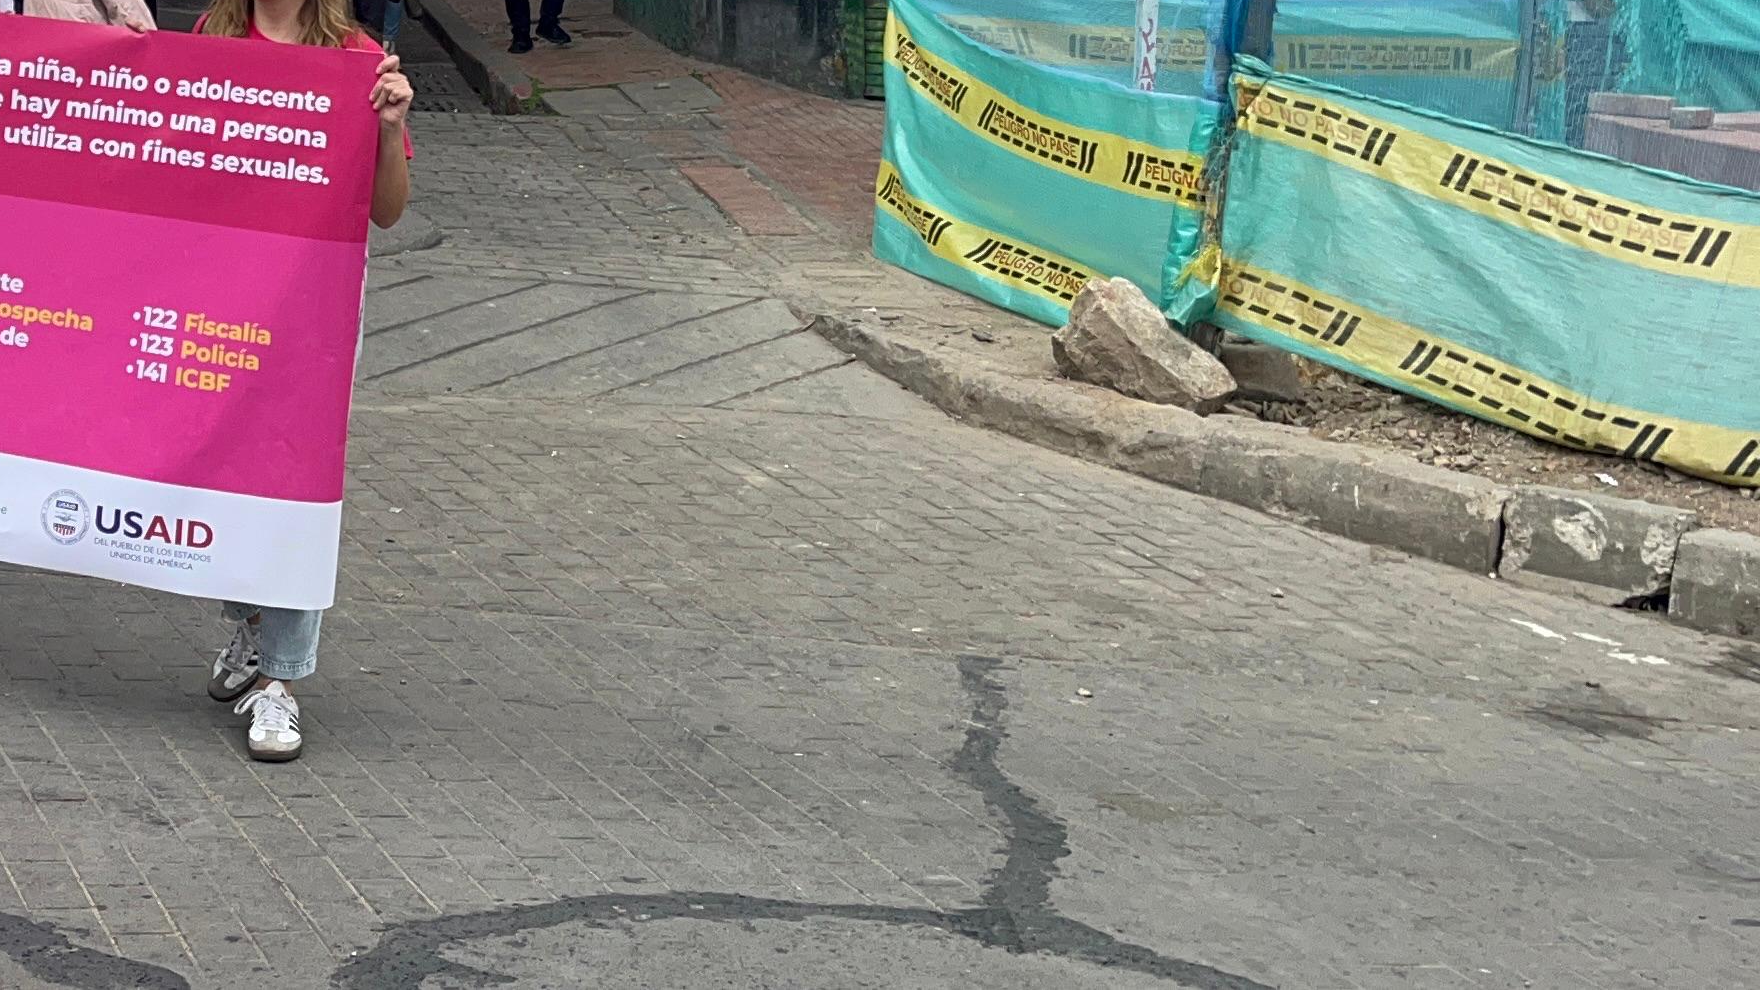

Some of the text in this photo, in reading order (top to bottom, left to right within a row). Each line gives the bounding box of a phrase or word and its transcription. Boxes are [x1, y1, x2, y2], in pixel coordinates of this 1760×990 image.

[18, 57, 84, 89] niña,
[89, 64, 148, 93] niño
[153, 76, 170, 94] o
[175, 77, 332, 114] adolescente
[10, 88, 61, 120] hay
[65, 97, 164, 129] mínimo
[169, 113, 217, 136] una
[221, 118, 328, 149] persona
[993, 112, 1078, 159] PELIGRO NO PASE
[1280, 105, 1366, 147] NO PASE
[2, 123, 83, 153] utiliza
[88, 136, 136, 160] con
[140, 139, 205, 169] fines
[209, 153, 331, 187] sexuales.
[992, 249, 1045, 277] PELIGRO
[1043, 270, 1064, 287] NO
[183, 312, 272, 347] Fiscalía
[179, 339, 261, 372] Policía
[174, 365, 232, 395] ICBF
[94, 504, 215, 550] USAID
[94, 536, 213, 564] DEL PUEBLO DE LOS ESTADOS
[110, 551, 194, 571] UNIDOS DE AMÉRICA
